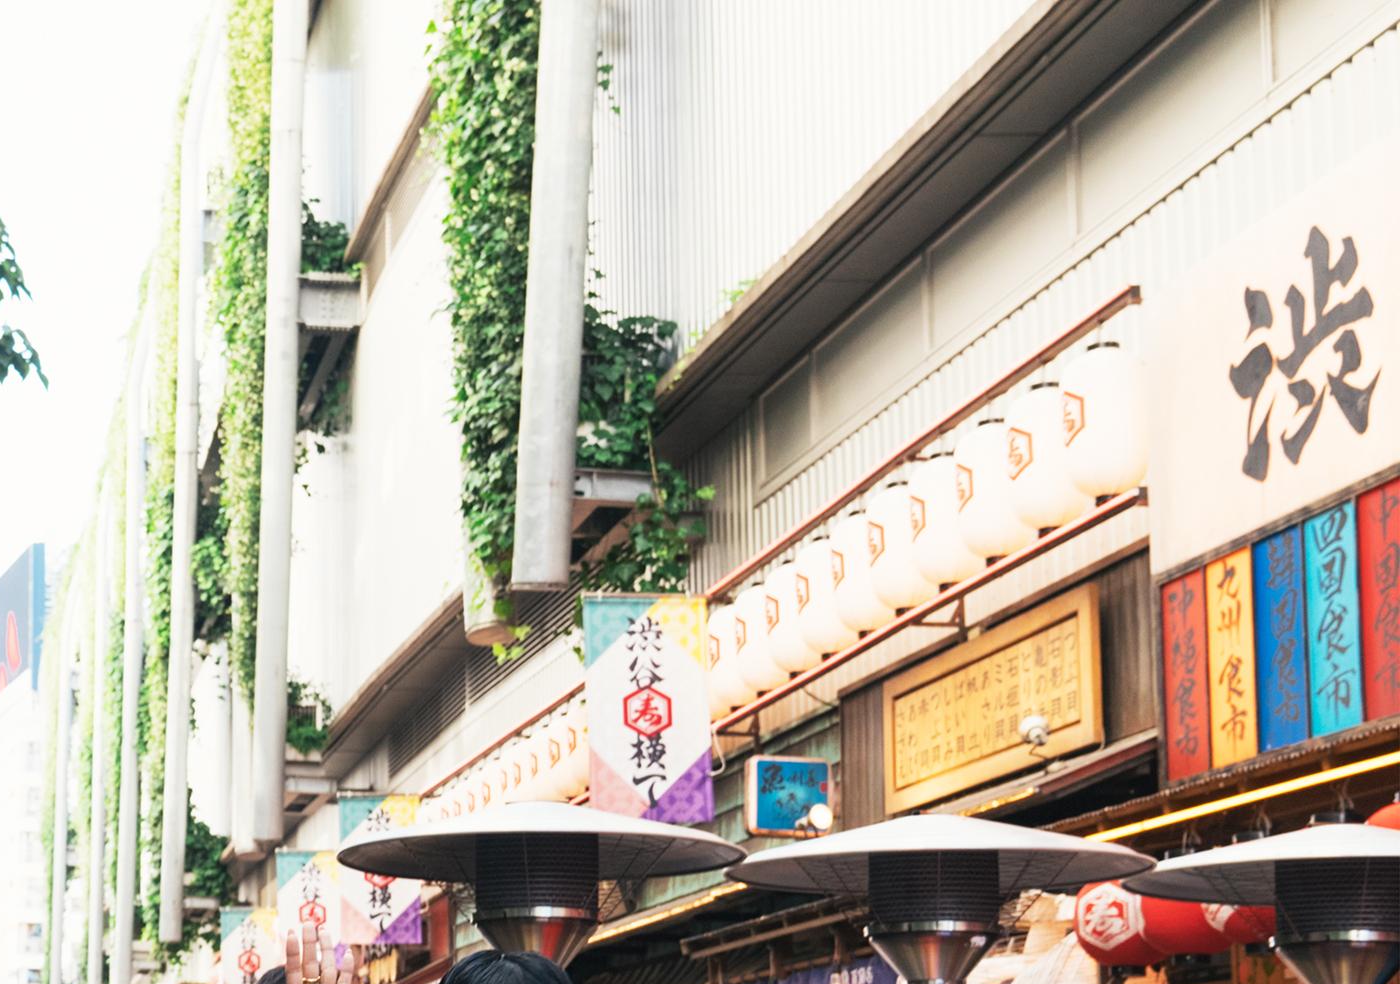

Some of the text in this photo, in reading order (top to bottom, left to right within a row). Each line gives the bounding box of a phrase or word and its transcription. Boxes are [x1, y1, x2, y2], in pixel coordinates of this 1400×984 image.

[1229, 225, 1382, 482] 渋
[1217, 558, 1248, 744] 九州食市
[1311, 504, 1357, 726] 四国食市
